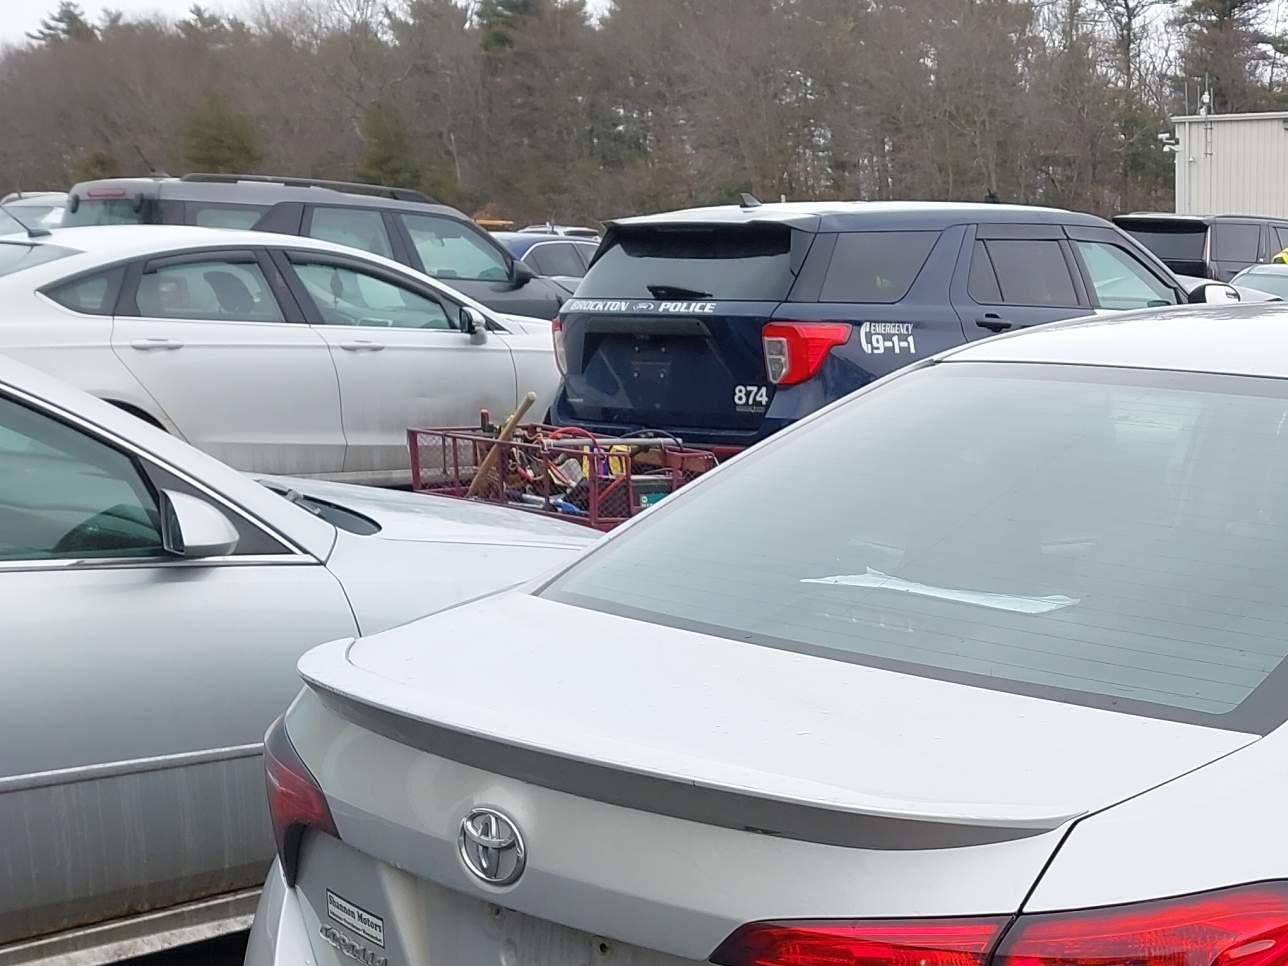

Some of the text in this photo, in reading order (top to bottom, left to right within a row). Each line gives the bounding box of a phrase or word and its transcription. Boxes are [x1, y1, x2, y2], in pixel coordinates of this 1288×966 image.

[570, 301, 629, 311] BROCKTON
[658, 302, 716, 313] POLICE
[870, 323, 914, 335] EMERGENCY
[872, 335, 916, 353] 9-1-1
[734, 385, 769, 405] 874
[328, 894, 356, 919] Shannon
[356, 910, 382, 933] Motors
